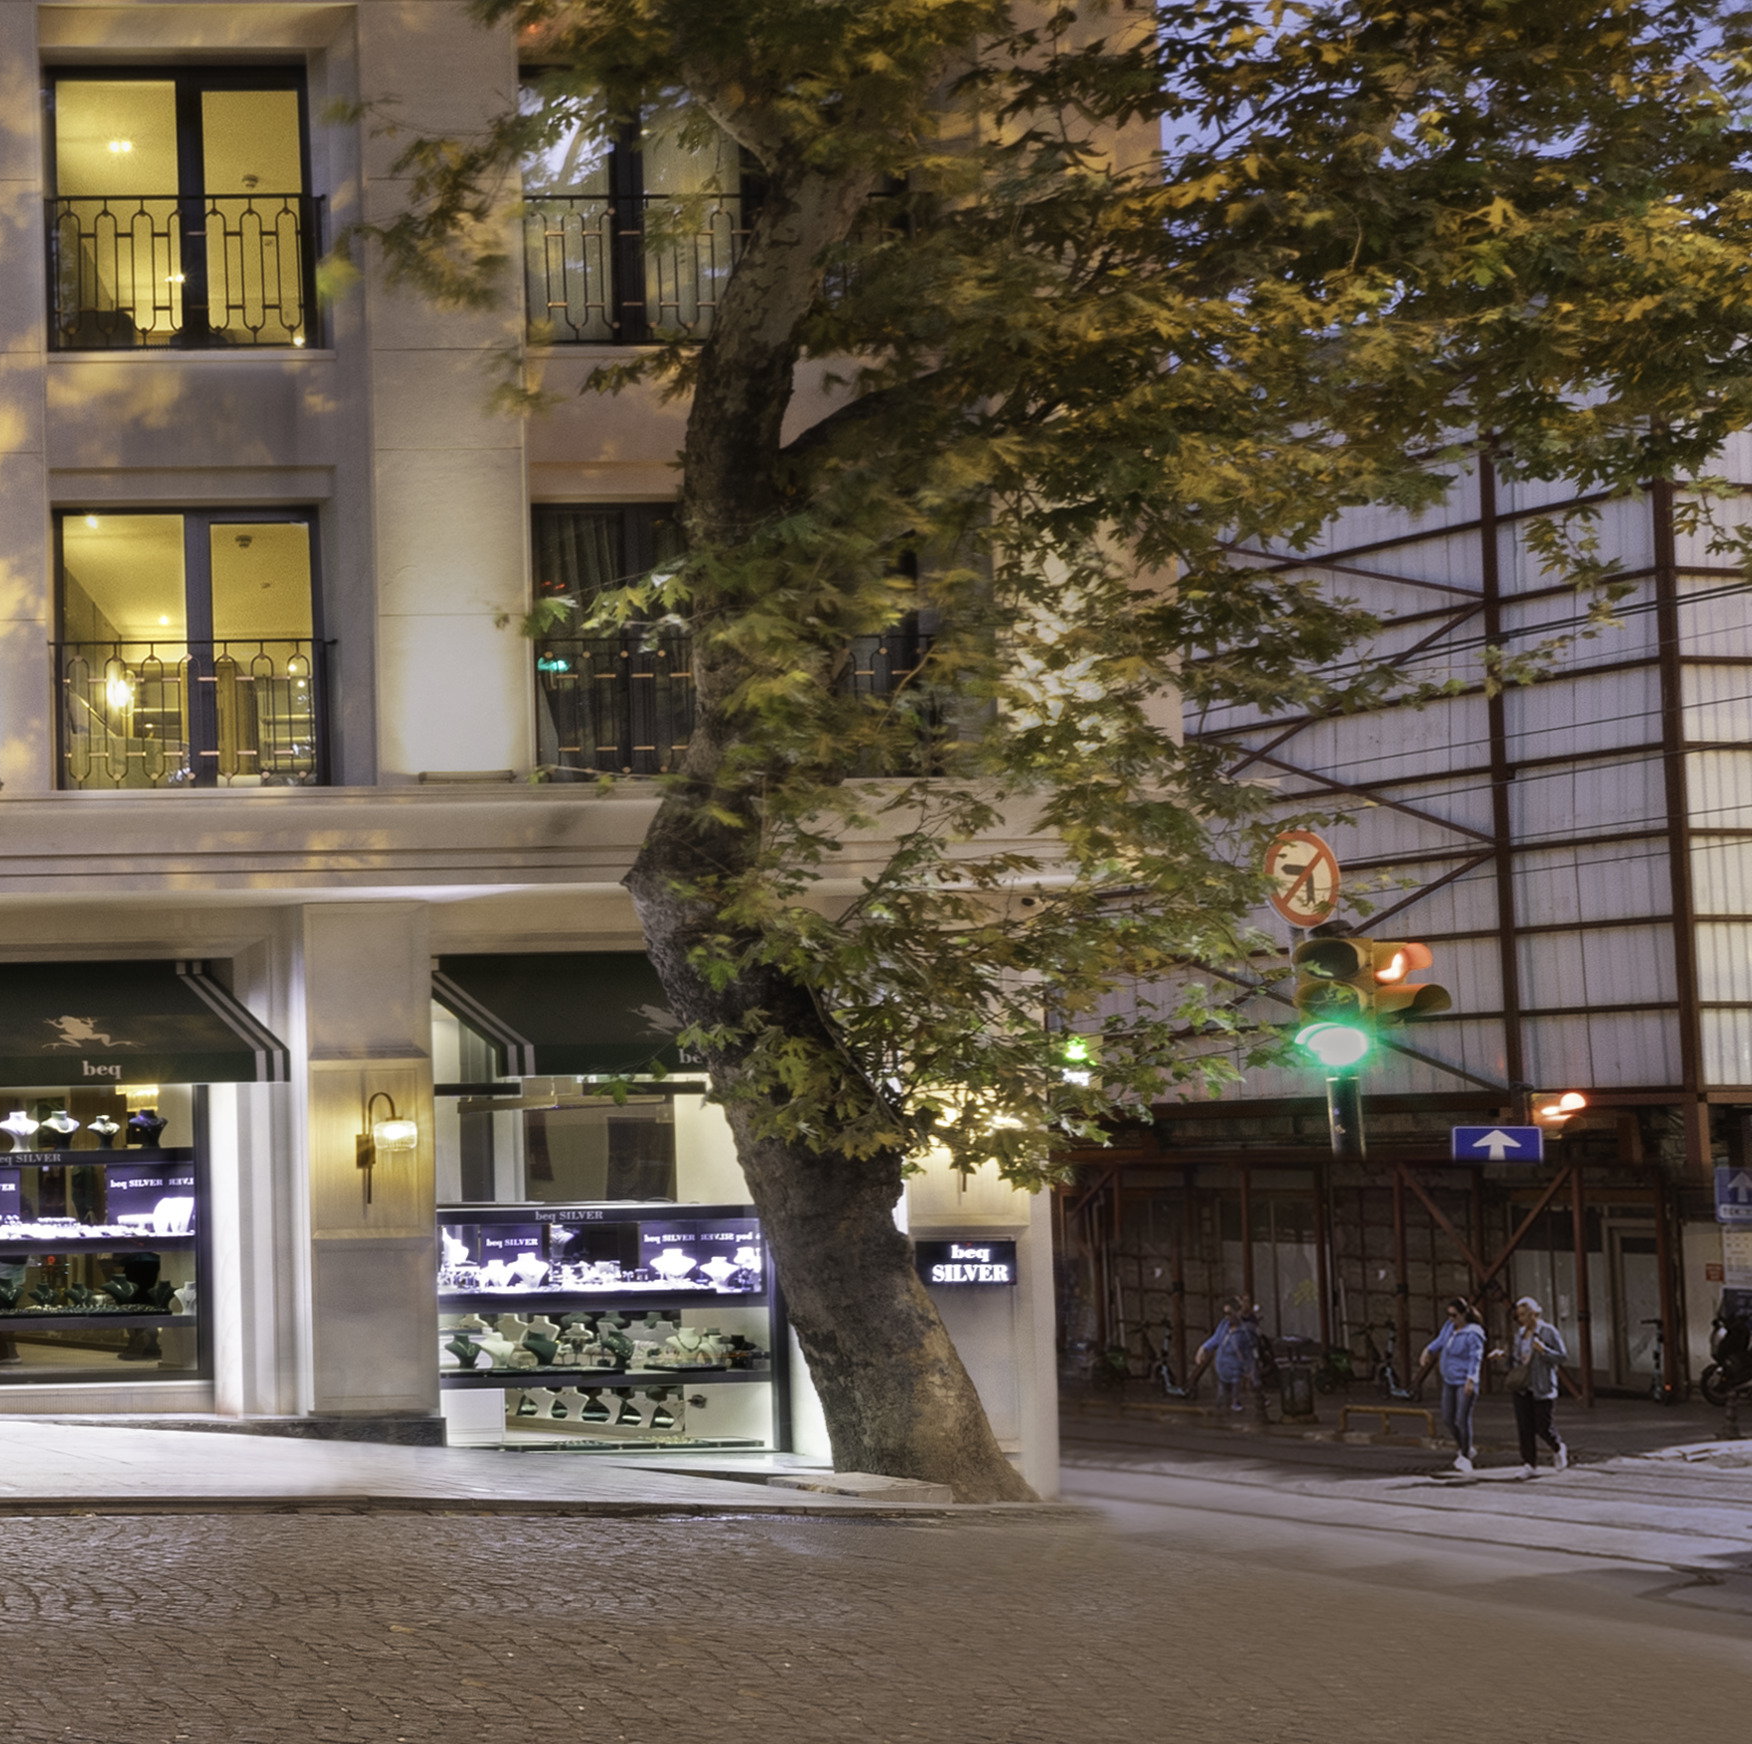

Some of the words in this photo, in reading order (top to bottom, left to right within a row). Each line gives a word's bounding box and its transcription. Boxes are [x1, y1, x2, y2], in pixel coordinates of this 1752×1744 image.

[678, 1048, 703, 1064] be
[82, 1060, 123, 1080] beq
[15, 1153, 61, 1163] SILVER
[109, 1179, 128, 1190] beq
[128, 1178, 163, 1187] SILVER
[535, 1211, 556, 1223] beq
[559, 1210, 603, 1220] SILVER
[486, 1238, 503, 1248] beq
[504, 1238, 538, 1246] SILVER
[644, 1234, 661, 1244] beq
[662, 1234, 695, 1242] SILVER
[950, 1244, 990, 1262] beq
[931, 1264, 1010, 1282] SILVER
